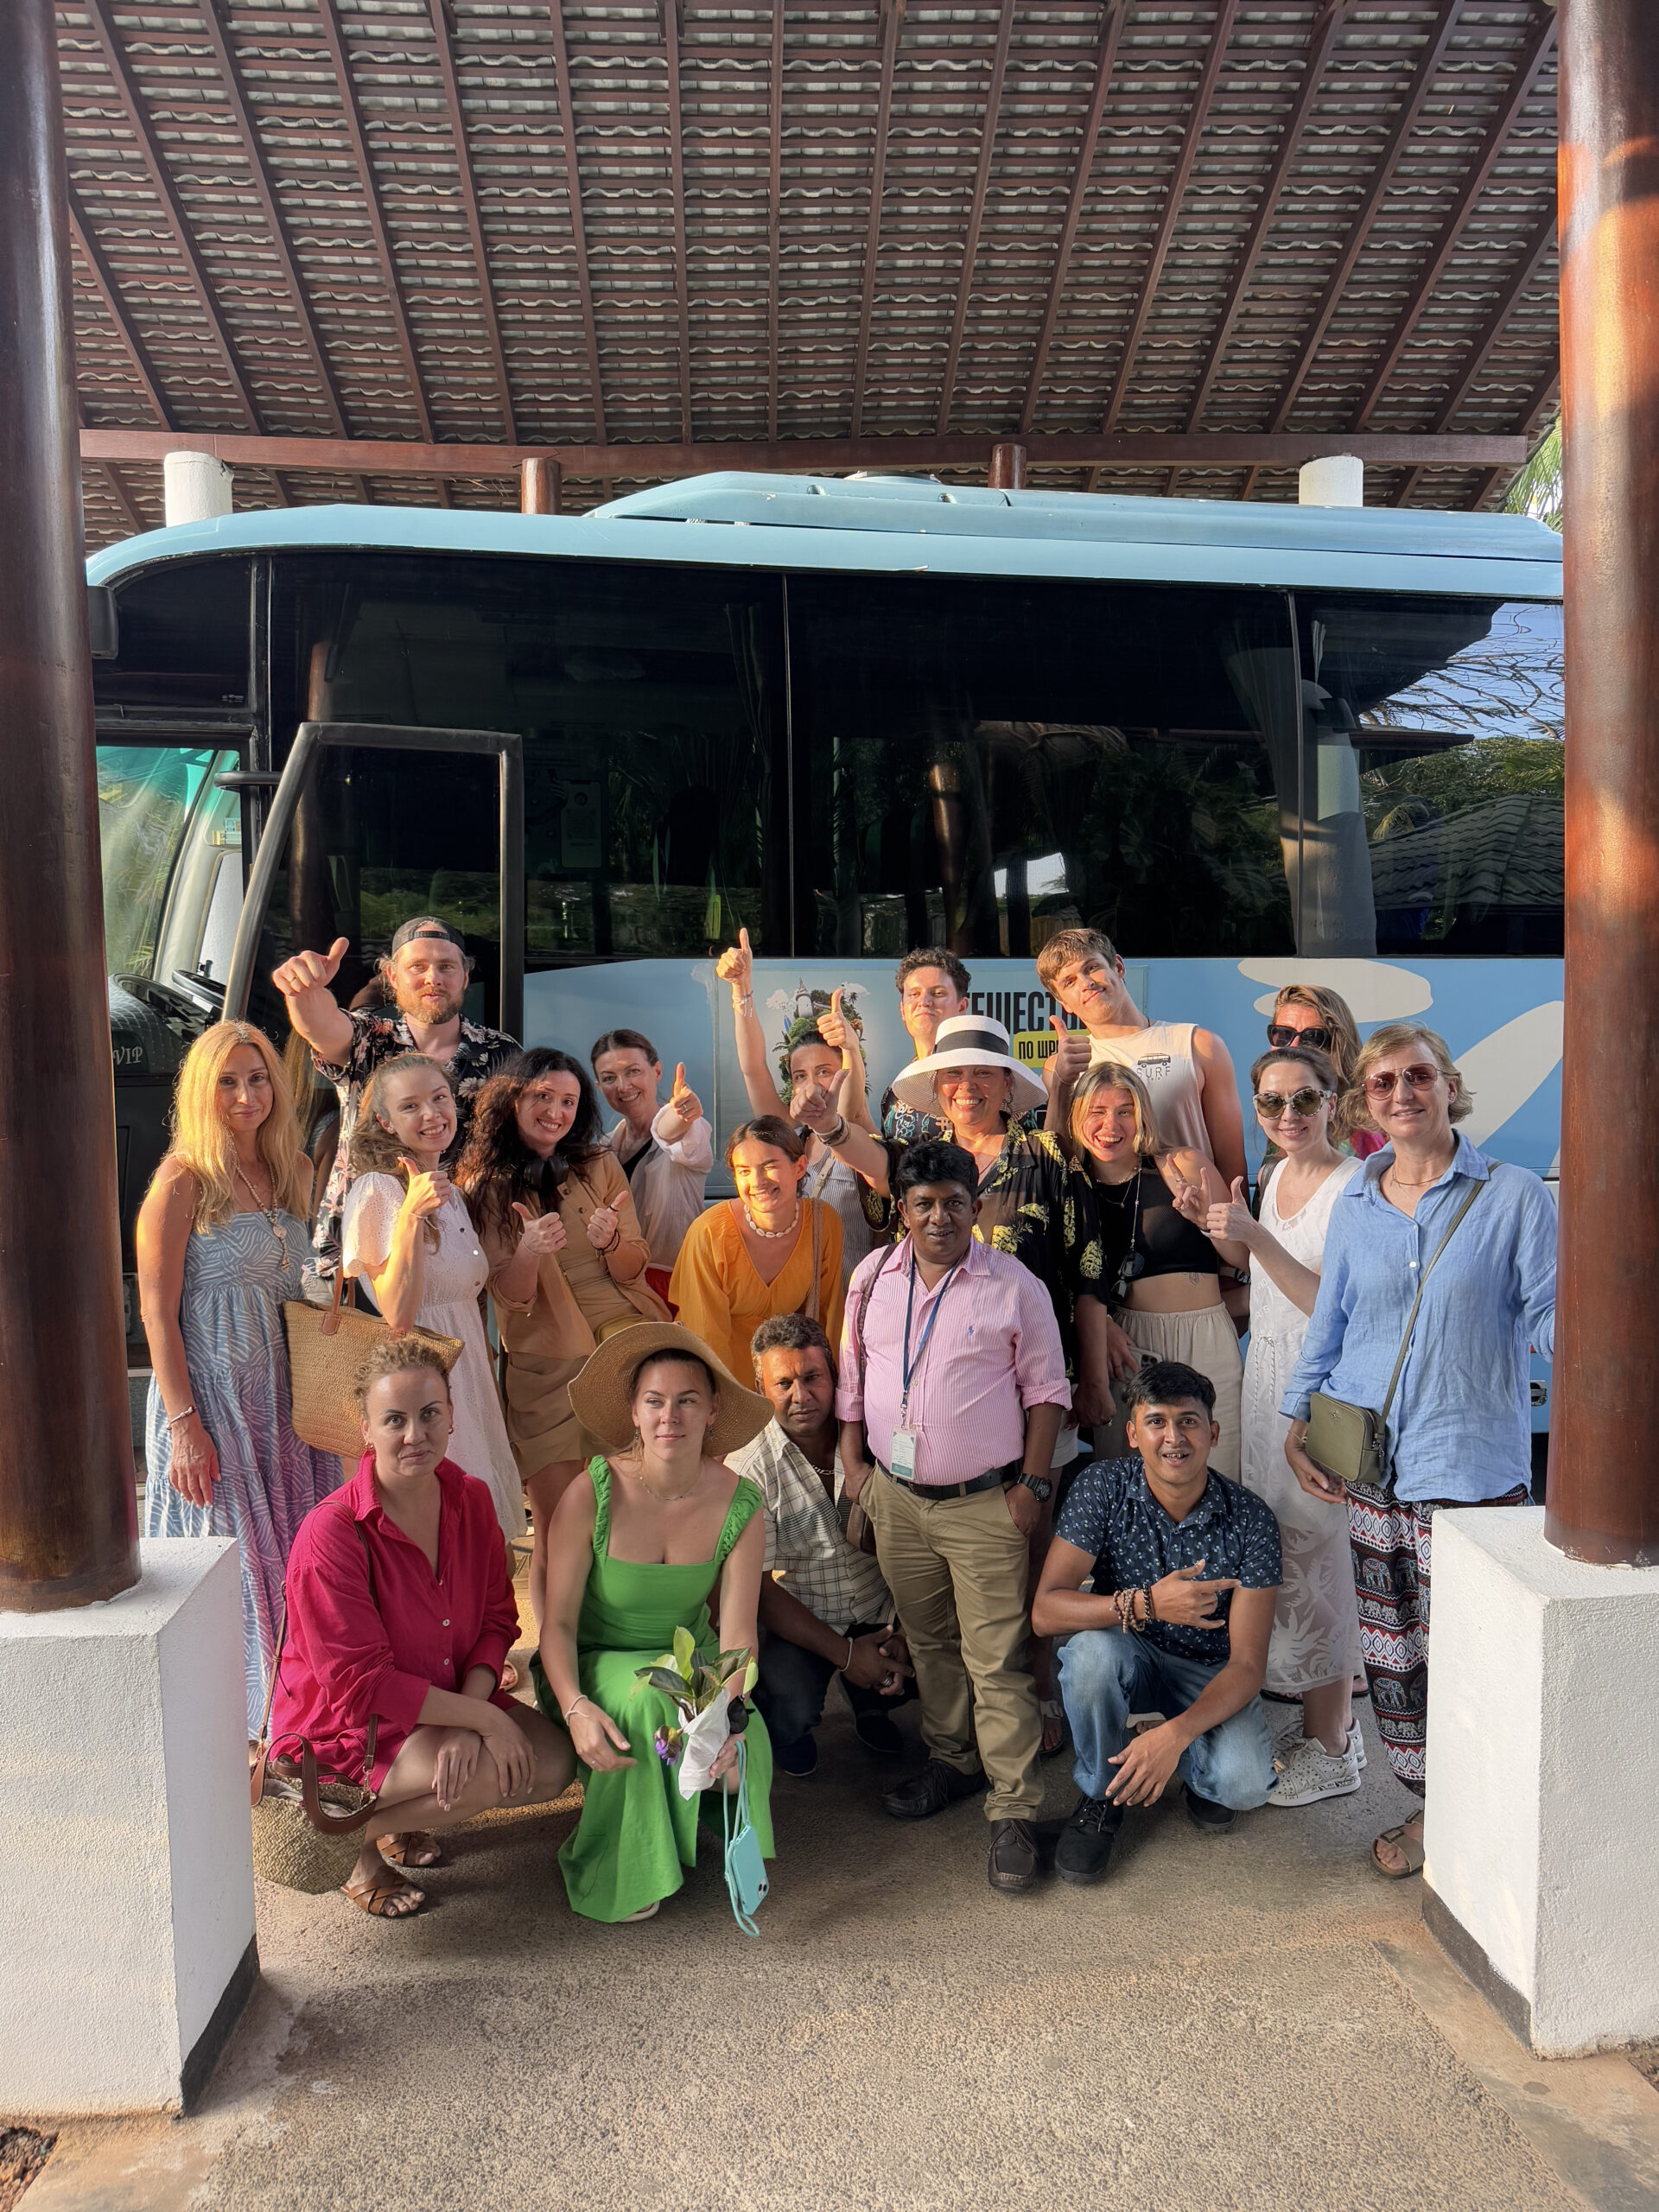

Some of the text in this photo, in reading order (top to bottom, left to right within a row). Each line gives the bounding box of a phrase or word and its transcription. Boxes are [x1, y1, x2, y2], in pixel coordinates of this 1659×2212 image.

[112, 1046, 143, 1065] VIP
[1019, 1039, 1058, 1059] ПО ШР
[1136, 1065, 1171, 1078] SURF
